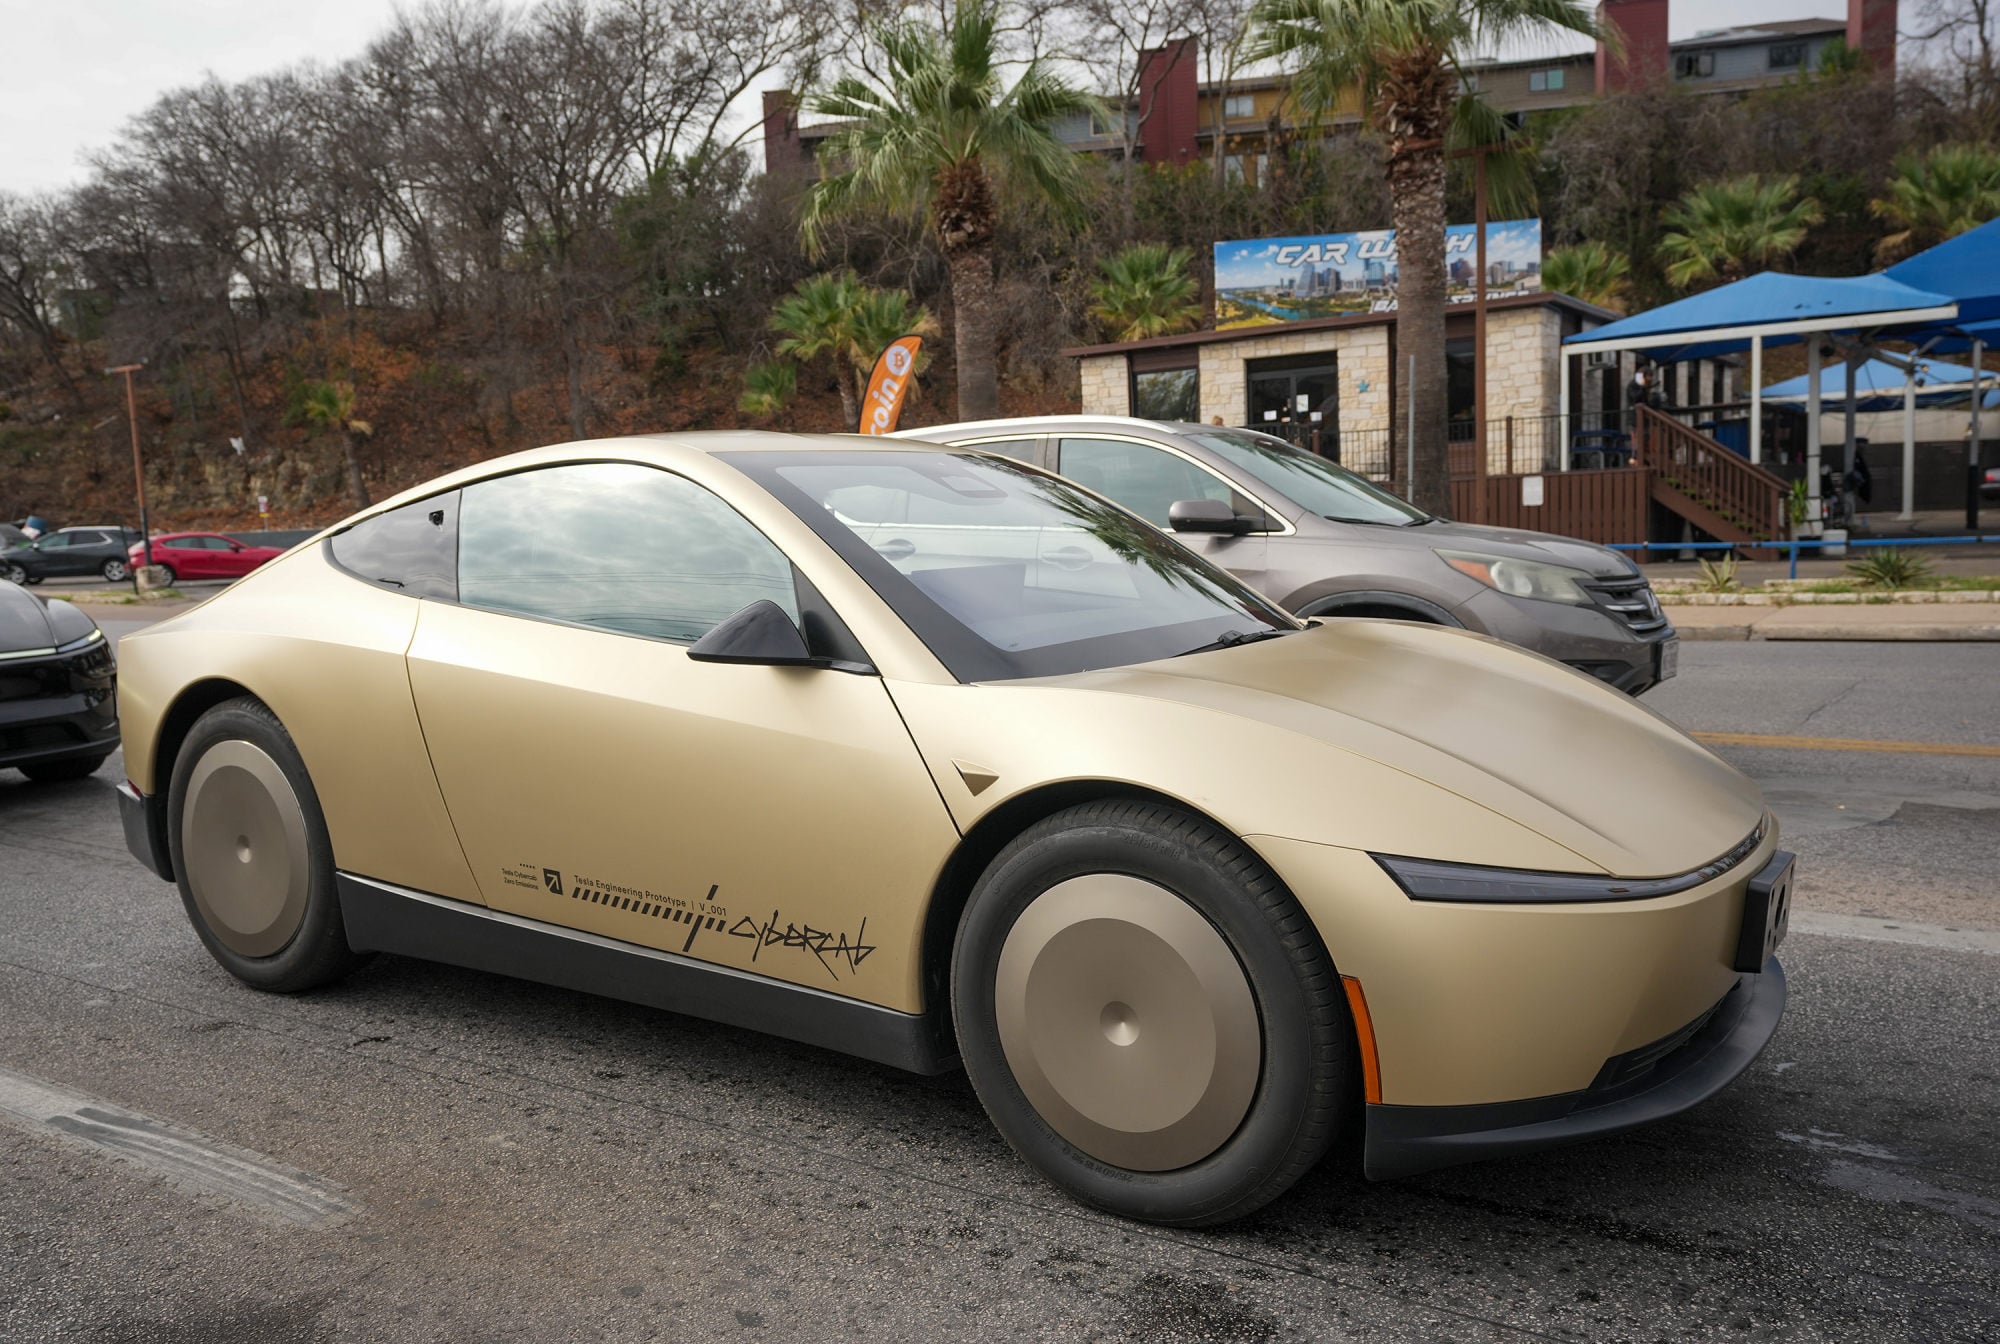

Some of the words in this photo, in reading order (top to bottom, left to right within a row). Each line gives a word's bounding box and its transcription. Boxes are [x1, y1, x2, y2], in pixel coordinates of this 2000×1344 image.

[1275, 242, 1349, 268] CAR
[1357, 233, 1475, 262] WH
[574, 875, 594, 887] Tesla
[595, 880, 643, 899] Engineering
[645, 890, 687, 907] Prototype
